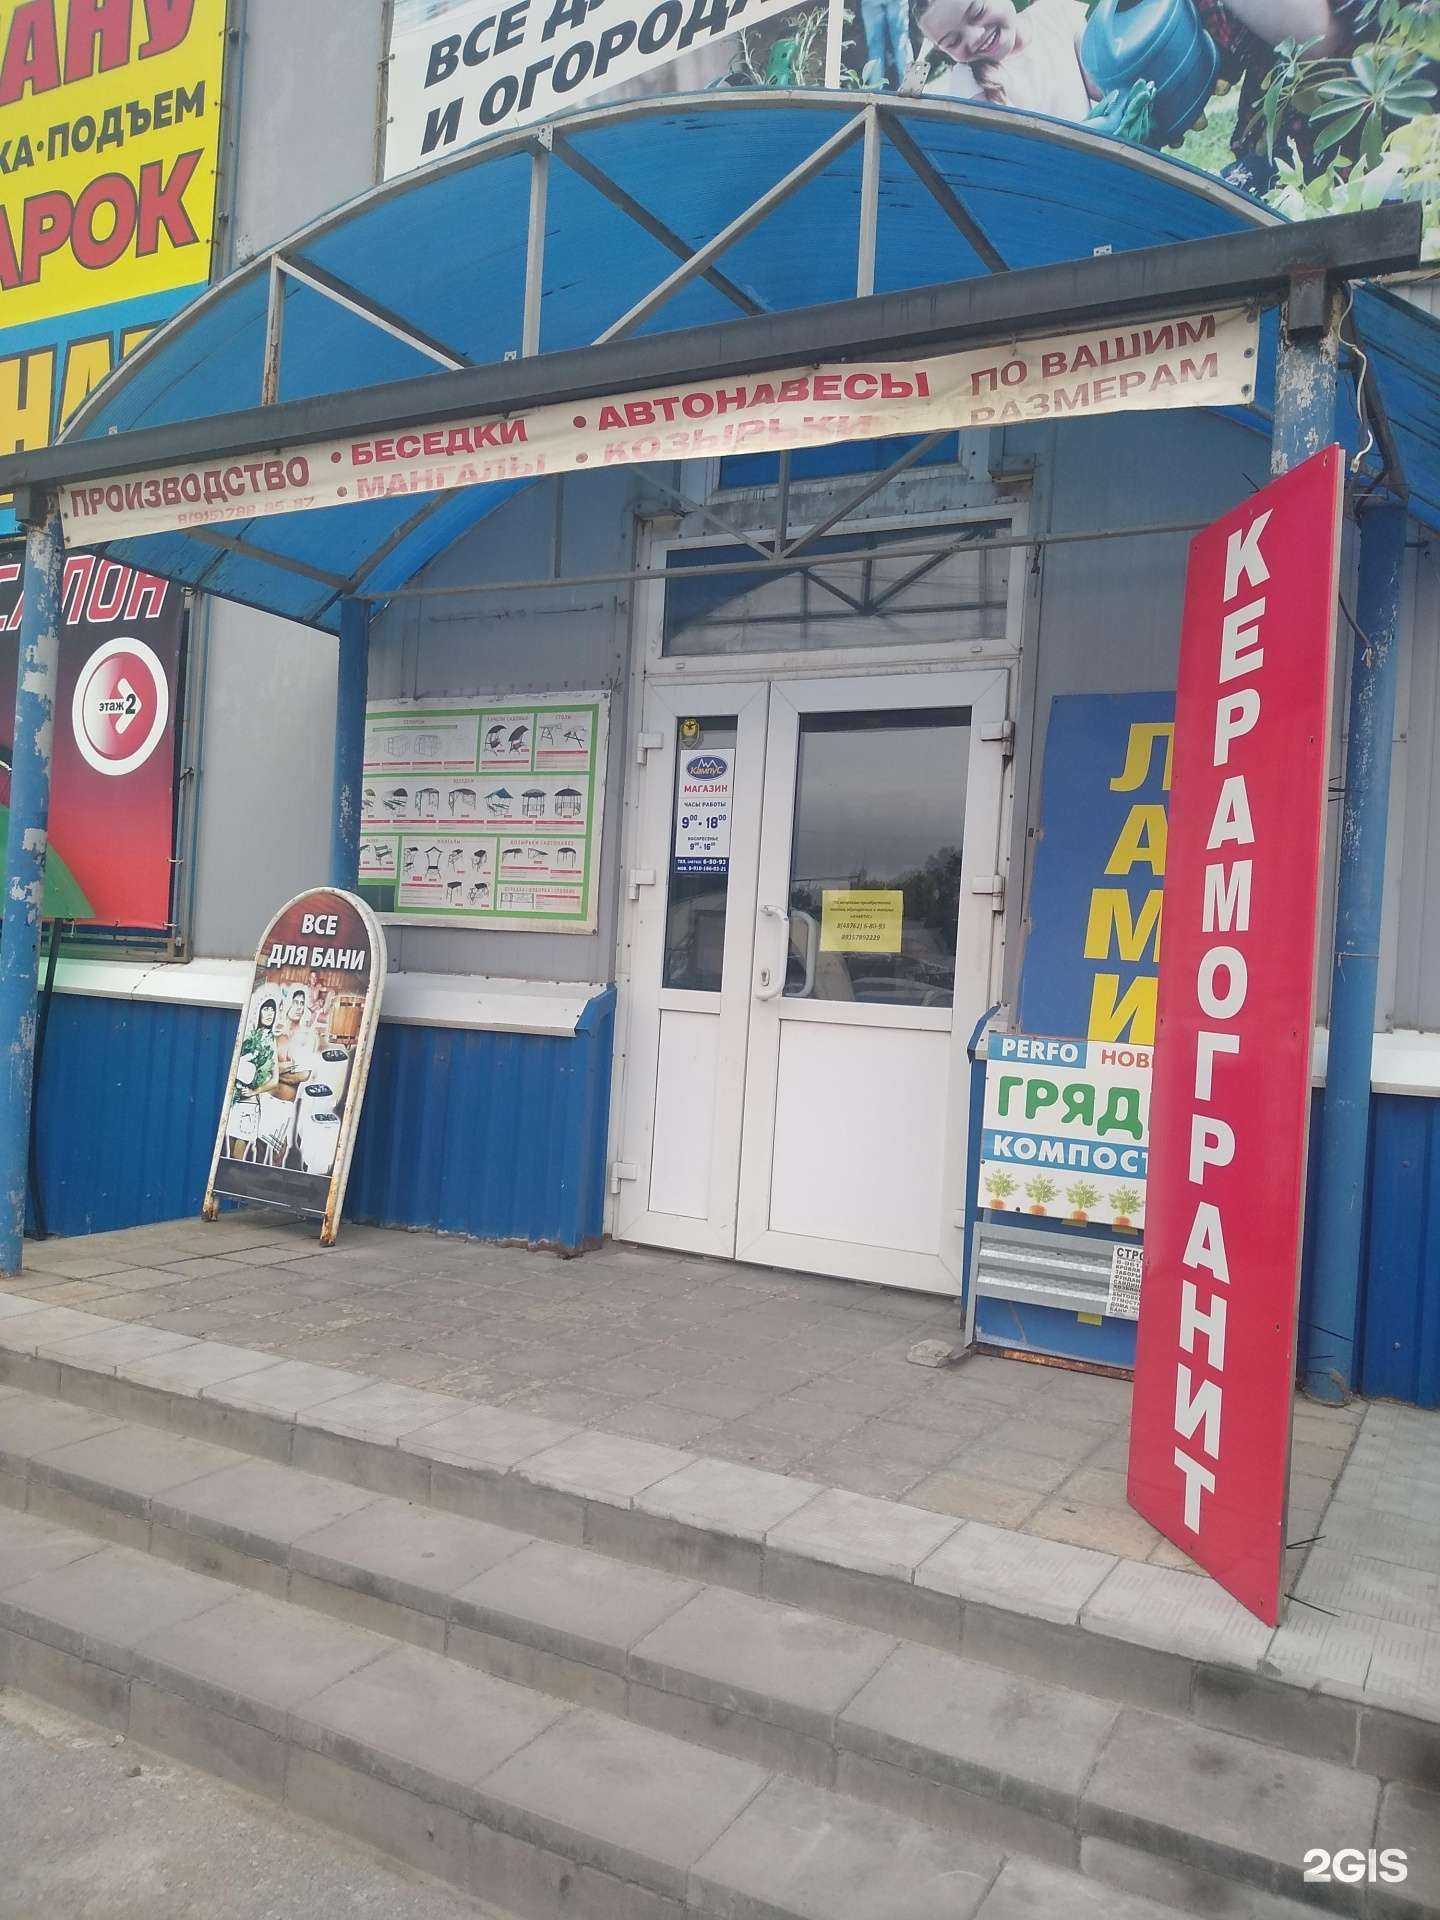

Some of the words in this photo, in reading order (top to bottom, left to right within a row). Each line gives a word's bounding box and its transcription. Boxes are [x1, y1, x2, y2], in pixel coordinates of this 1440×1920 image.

[424, 0, 530, 89] ВСЕ
[420, 97, 463, 155] И
[970, 360, 1028, 396] ПО
[1041, 314, 1216, 379] ВАШИМ
[598, 371, 931, 431] АВТОНАВЕСЫ
[969, 352, 1218, 425] РАЗМЕРАМ
[351, 419, 529, 465] БЕСЕДКИ
[70, 456, 310, 518] ПРОИЗВОДСТВО
[98, 701, 125, 712] этаж
[125, 693, 137, 715] 2
[684, 784, 728, 793] МАГАЗИН
[301, 913, 338, 936] ВСЕ
[266, 943, 309, 969] ДЛЯ
[310, 946, 366, 971] БАНИ
[1001, 1037, 1079, 1063] PERFO
[1174, 508, 1271, 1535] КЕРАМОГРАНИТ
